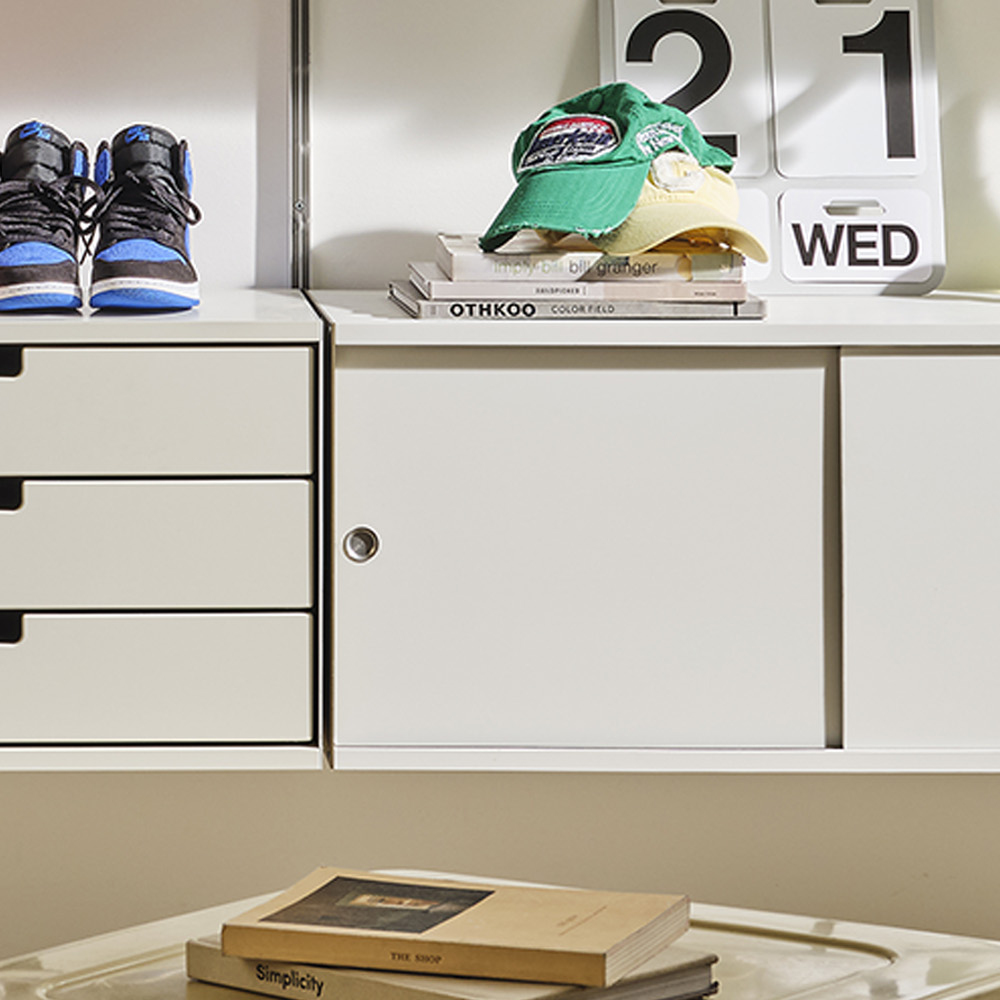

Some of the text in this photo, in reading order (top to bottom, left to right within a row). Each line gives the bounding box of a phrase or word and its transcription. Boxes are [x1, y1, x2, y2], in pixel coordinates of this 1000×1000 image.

[792, 223, 919, 267] WED
[597, 262, 658, 277] granger
[449, 303, 615, 317] OTHKOO COLOR FIELD
[390, 952, 442, 964] THE SHOP
[256, 963, 324, 997] Simplicity
